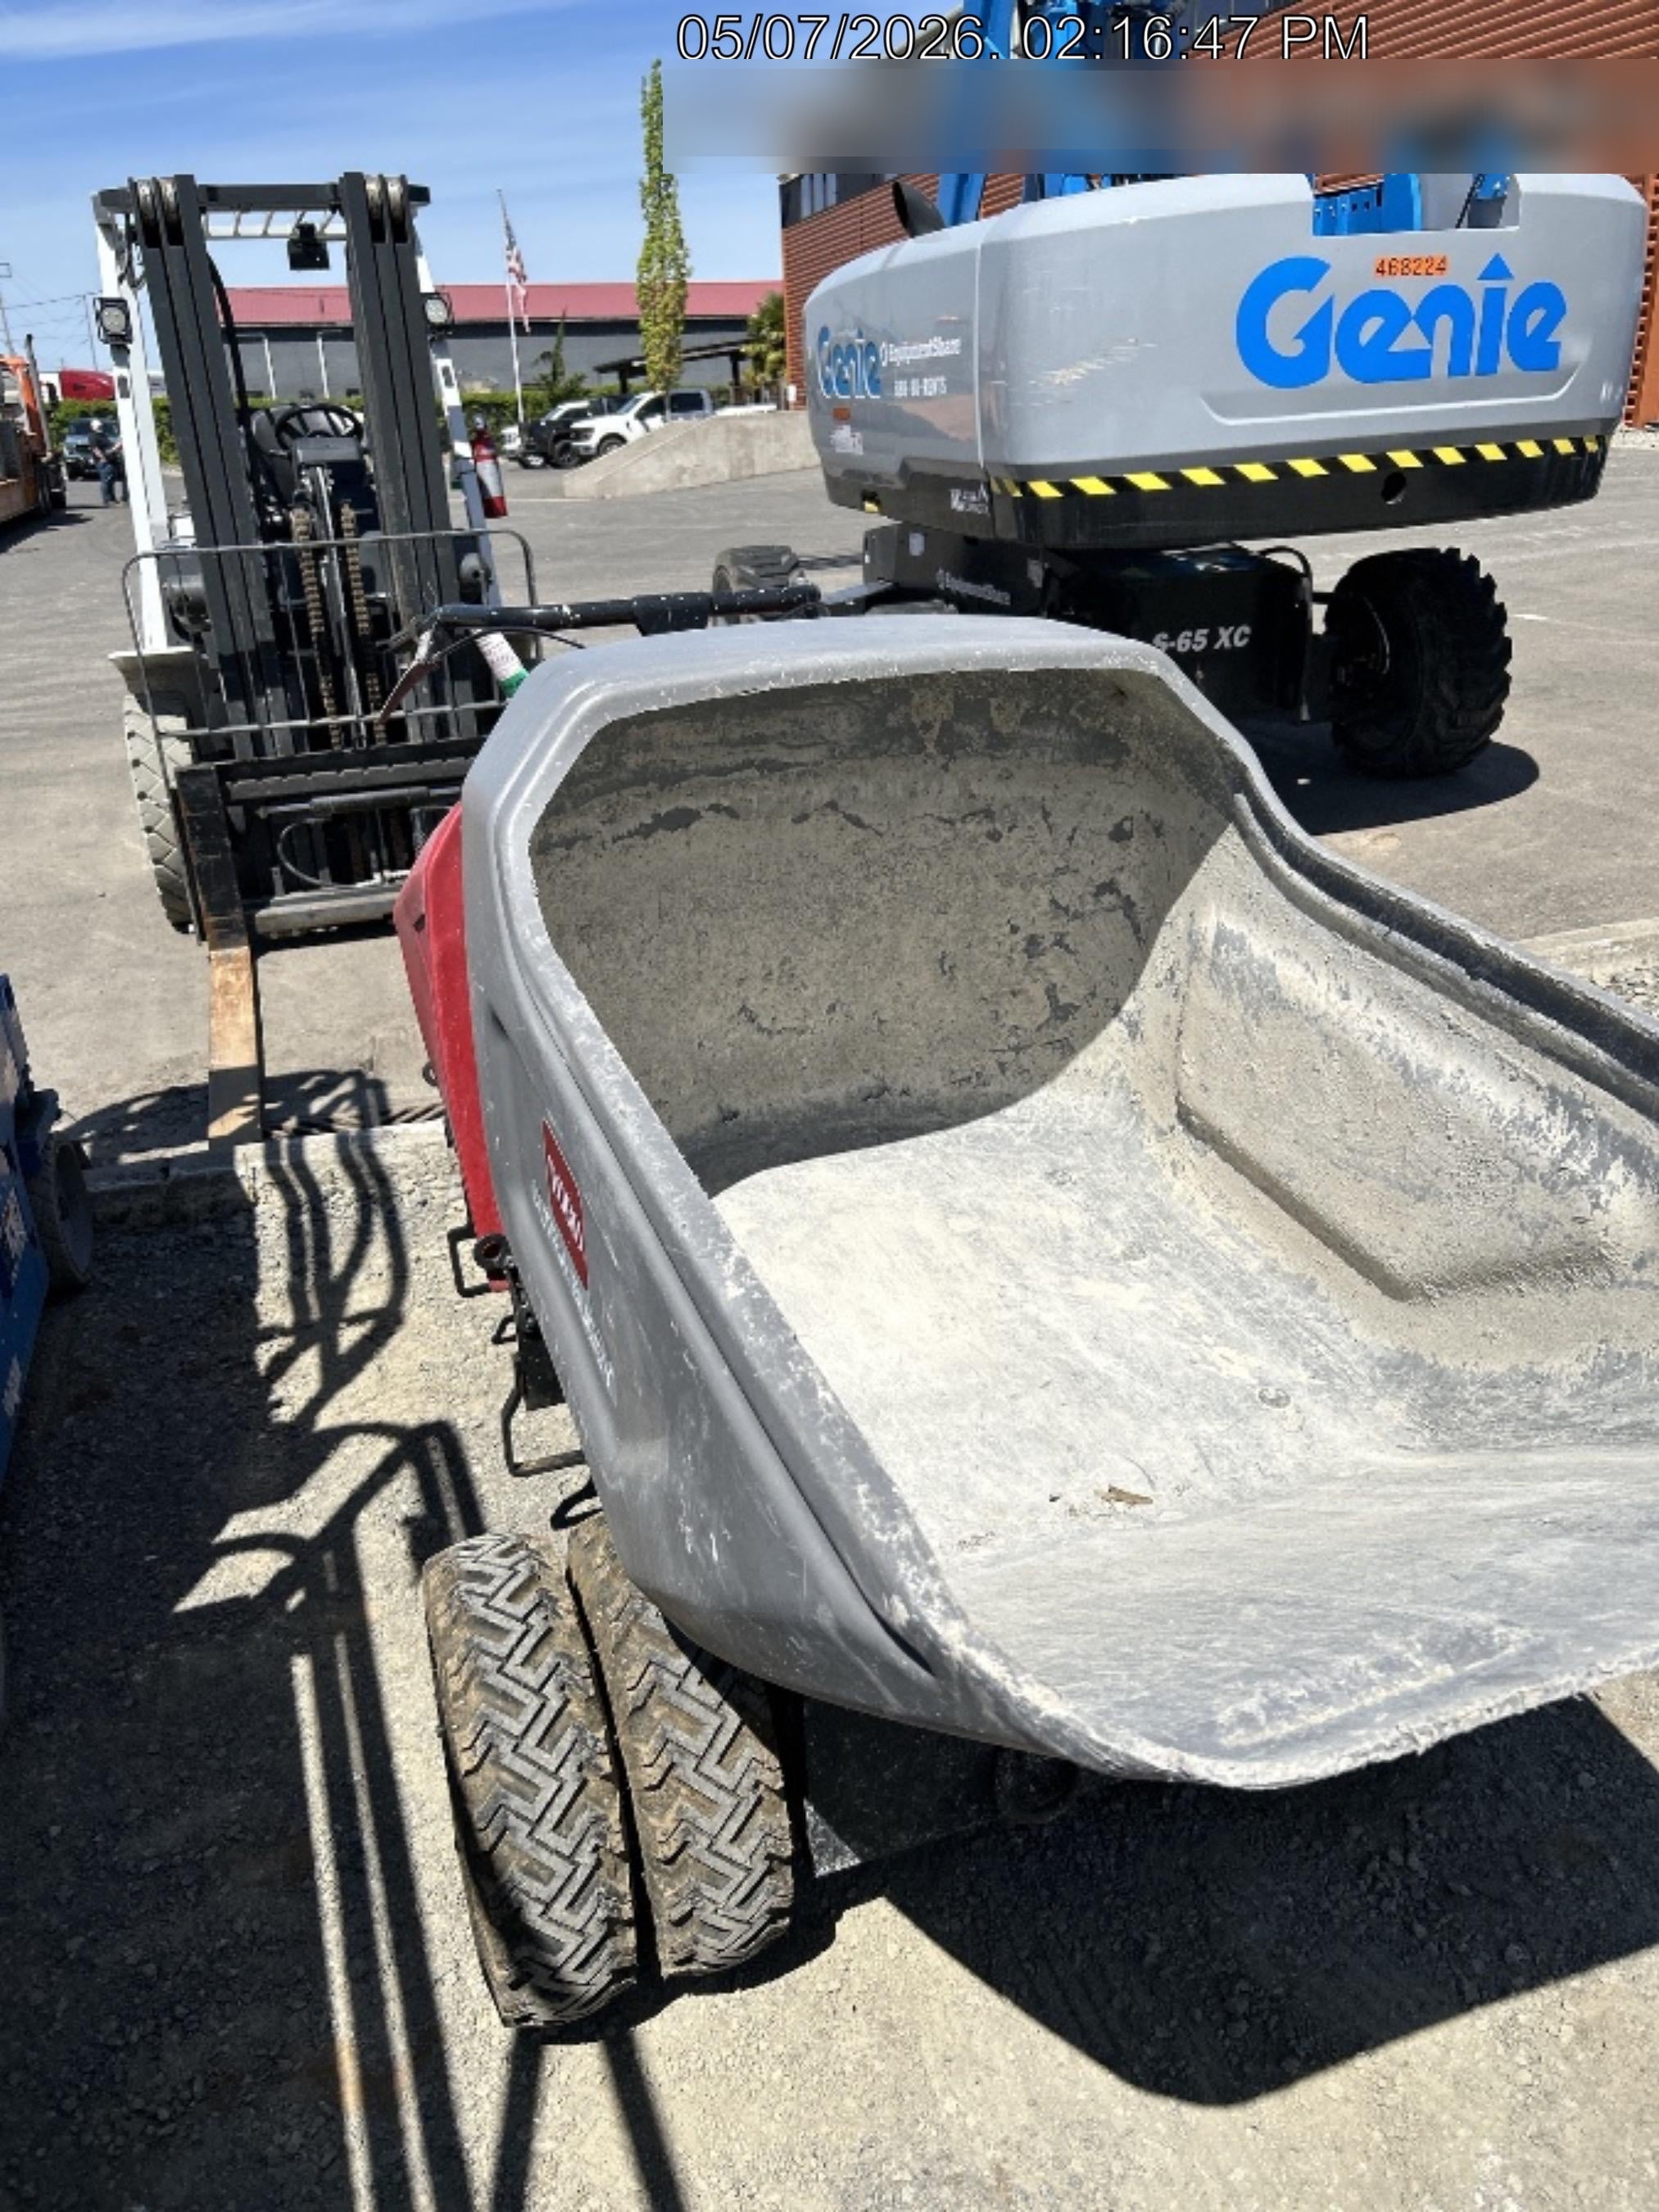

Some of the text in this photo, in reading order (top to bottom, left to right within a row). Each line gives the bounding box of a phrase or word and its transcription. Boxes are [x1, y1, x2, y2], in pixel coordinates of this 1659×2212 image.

[1376, 256, 1447, 276] 468224
[1235, 252, 1568, 389] Genie
[817, 324, 882, 399] Genie
[1152, 623, 1252, 652] S-65 XC
